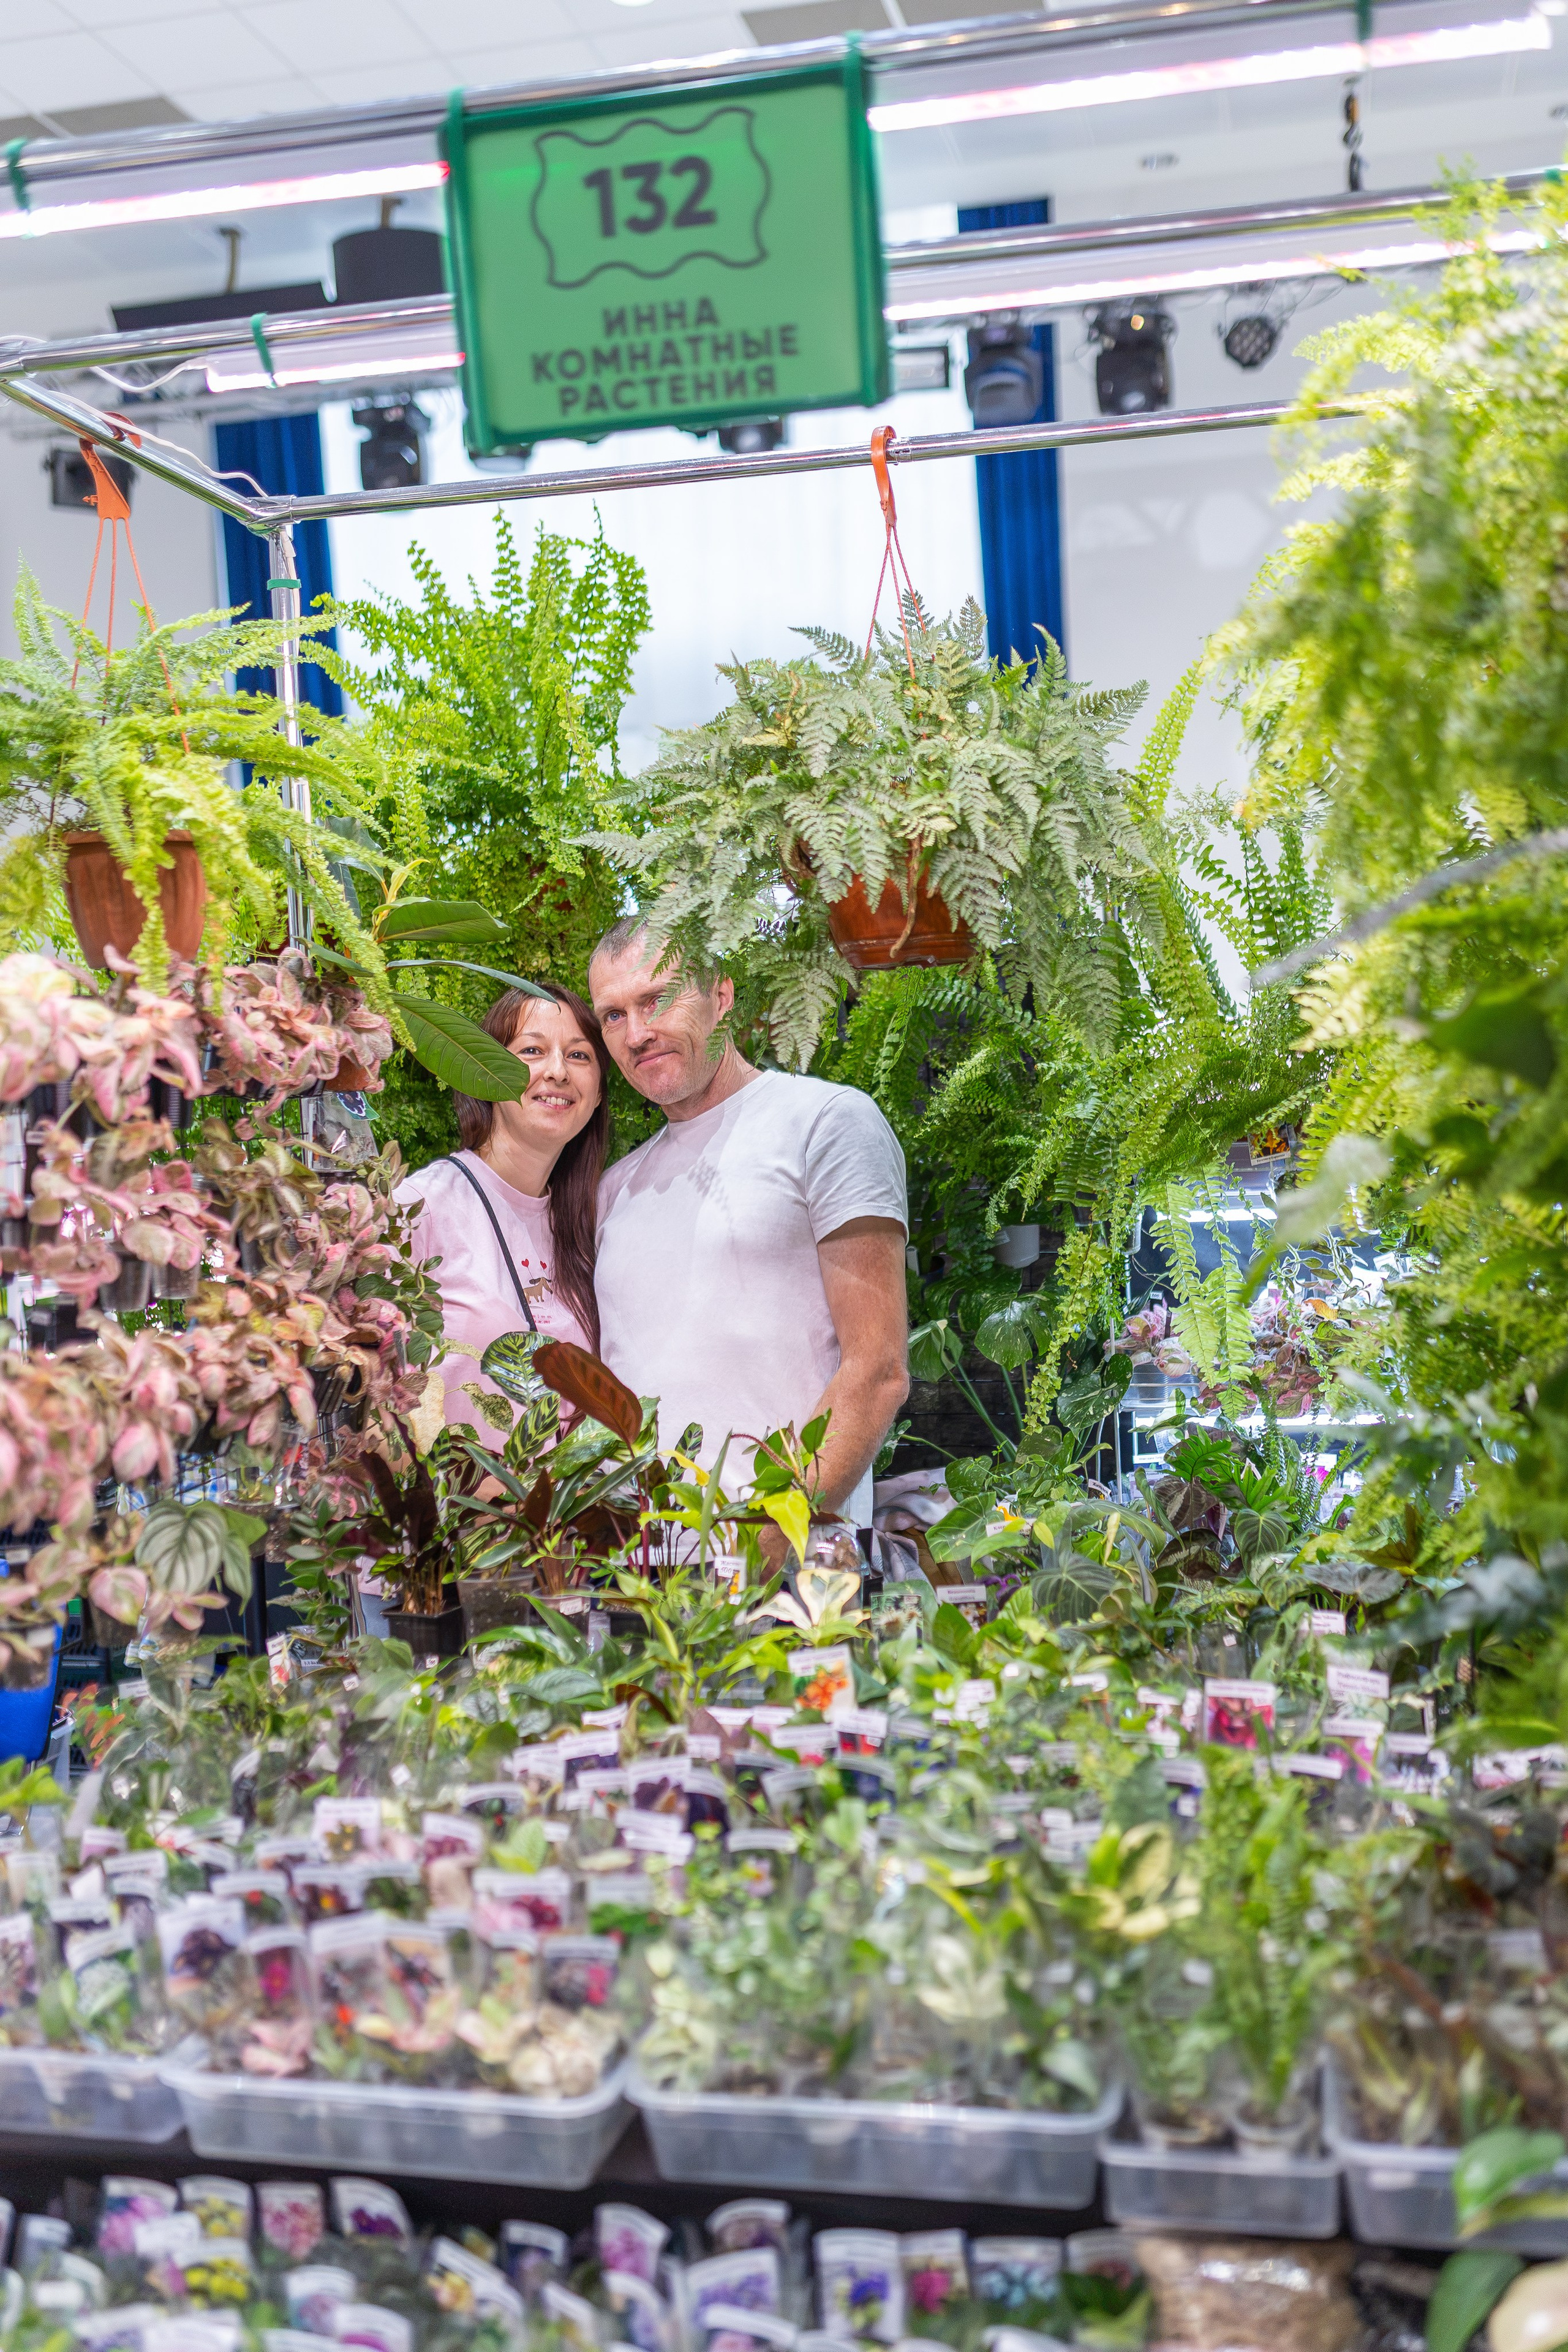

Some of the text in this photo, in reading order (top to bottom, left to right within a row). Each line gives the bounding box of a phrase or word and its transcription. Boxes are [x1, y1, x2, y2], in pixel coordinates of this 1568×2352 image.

[582, 156, 717, 238] 132
[601, 296, 720, 338] ИННА
[530, 324, 800, 383] КОМНАТНЫЕ
[559, 366, 778, 417] РАСТЕНИЯ
